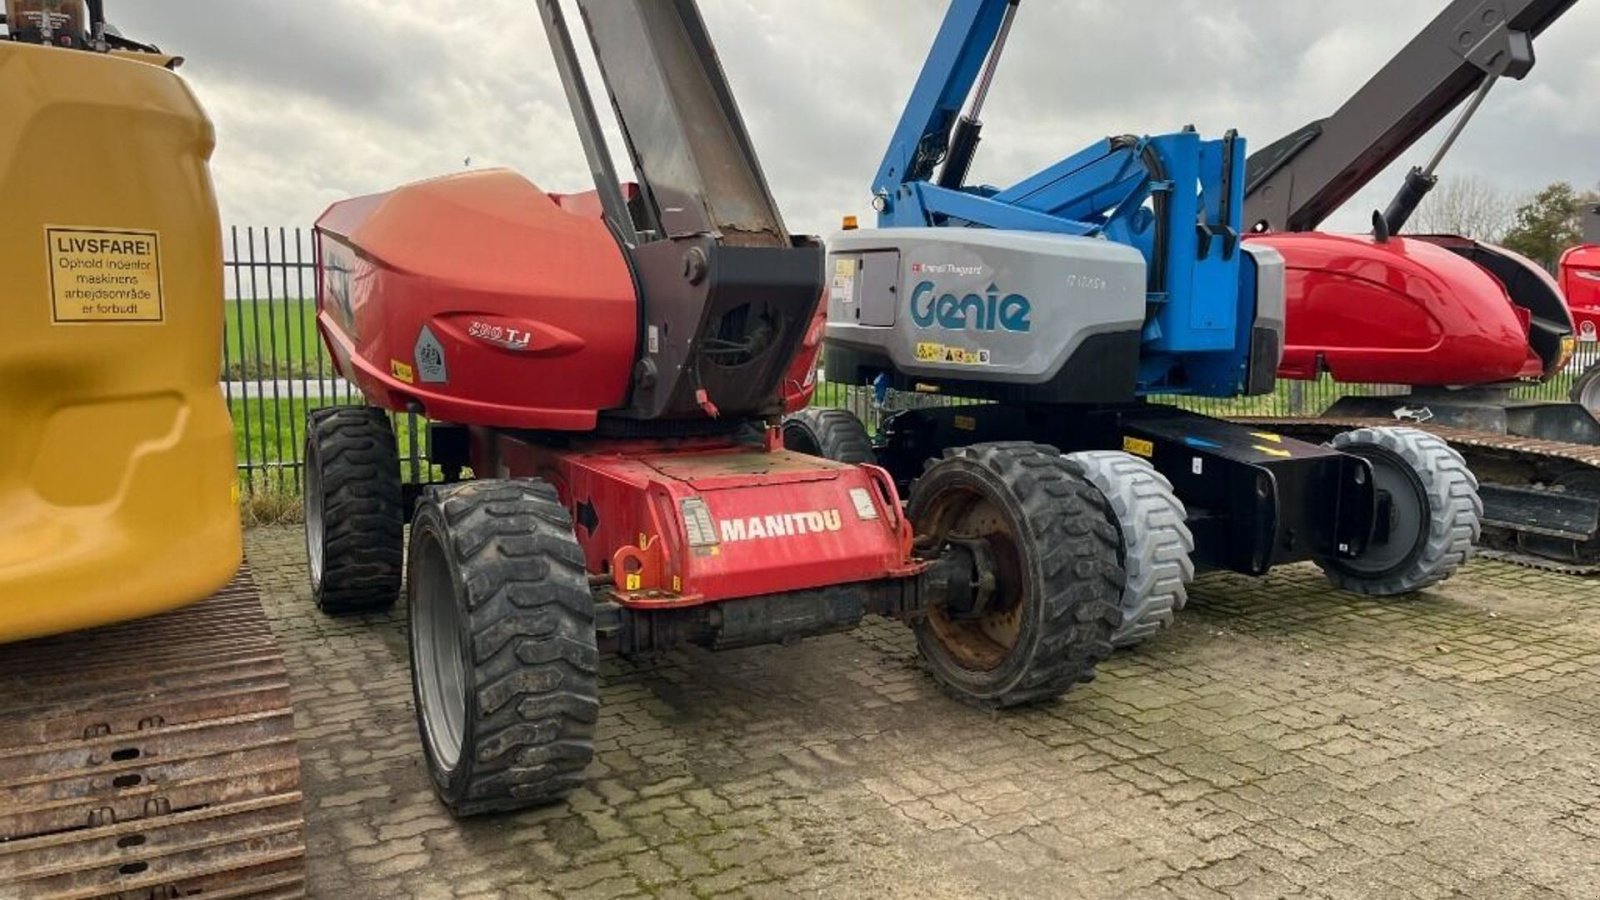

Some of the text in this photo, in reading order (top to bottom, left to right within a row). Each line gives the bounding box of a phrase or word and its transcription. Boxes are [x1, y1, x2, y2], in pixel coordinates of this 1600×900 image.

[57, 237, 151, 255] LIVSFARE!
[59, 257, 151, 271] Ophold indenfor
[76, 273, 138, 285] maskinens
[65, 288, 151, 301] arbejdsområde
[82, 304, 138, 314] er forbudt
[910, 281, 1030, 332] Genie
[720, 509, 842, 543] MANITOU
